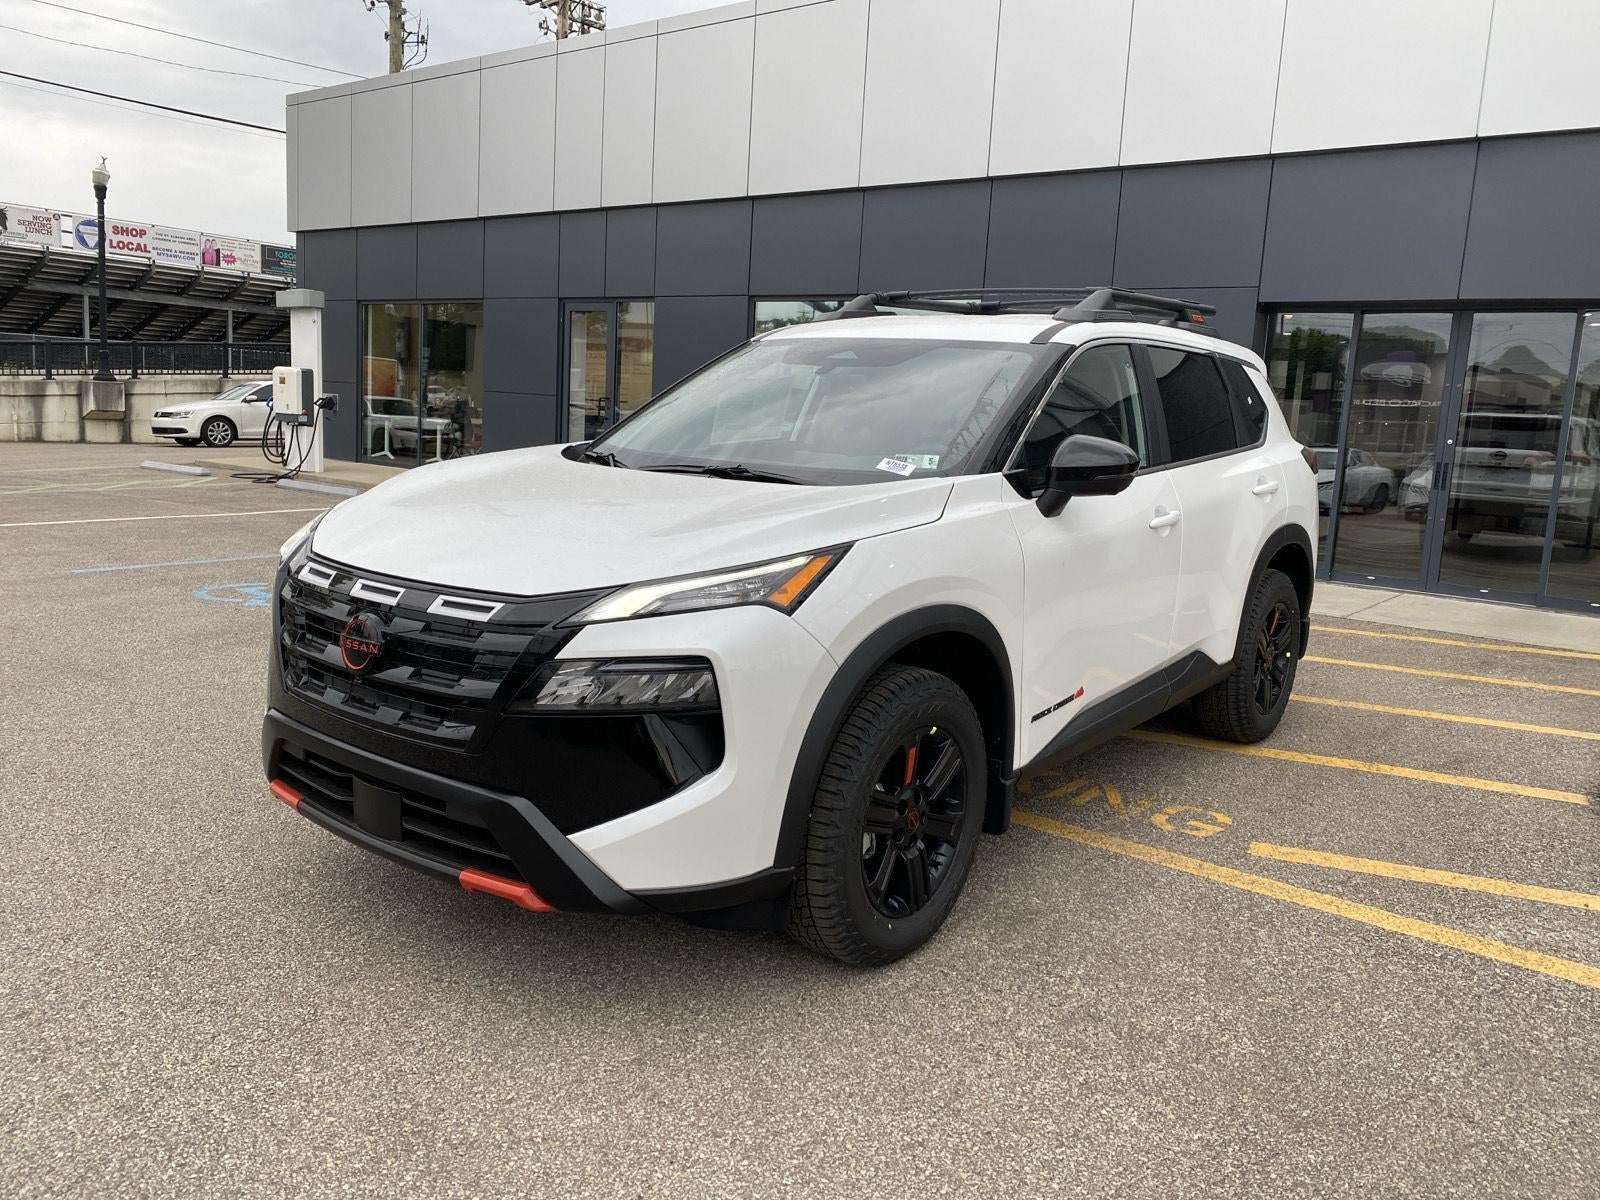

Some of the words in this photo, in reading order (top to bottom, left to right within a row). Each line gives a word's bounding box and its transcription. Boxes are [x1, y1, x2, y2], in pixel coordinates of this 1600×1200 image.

[32, 214, 52, 223] NOW
[17, 219, 52, 230] SERVING
[25, 226, 53, 236] LUNCH
[112, 225, 147, 238] SHOP
[109, 239, 151, 254] LOCAL
[156, 252, 196, 261] MYSAWV.COM
[928, 457, 934, 465] 5
[340, 633, 380, 655] SSAN
